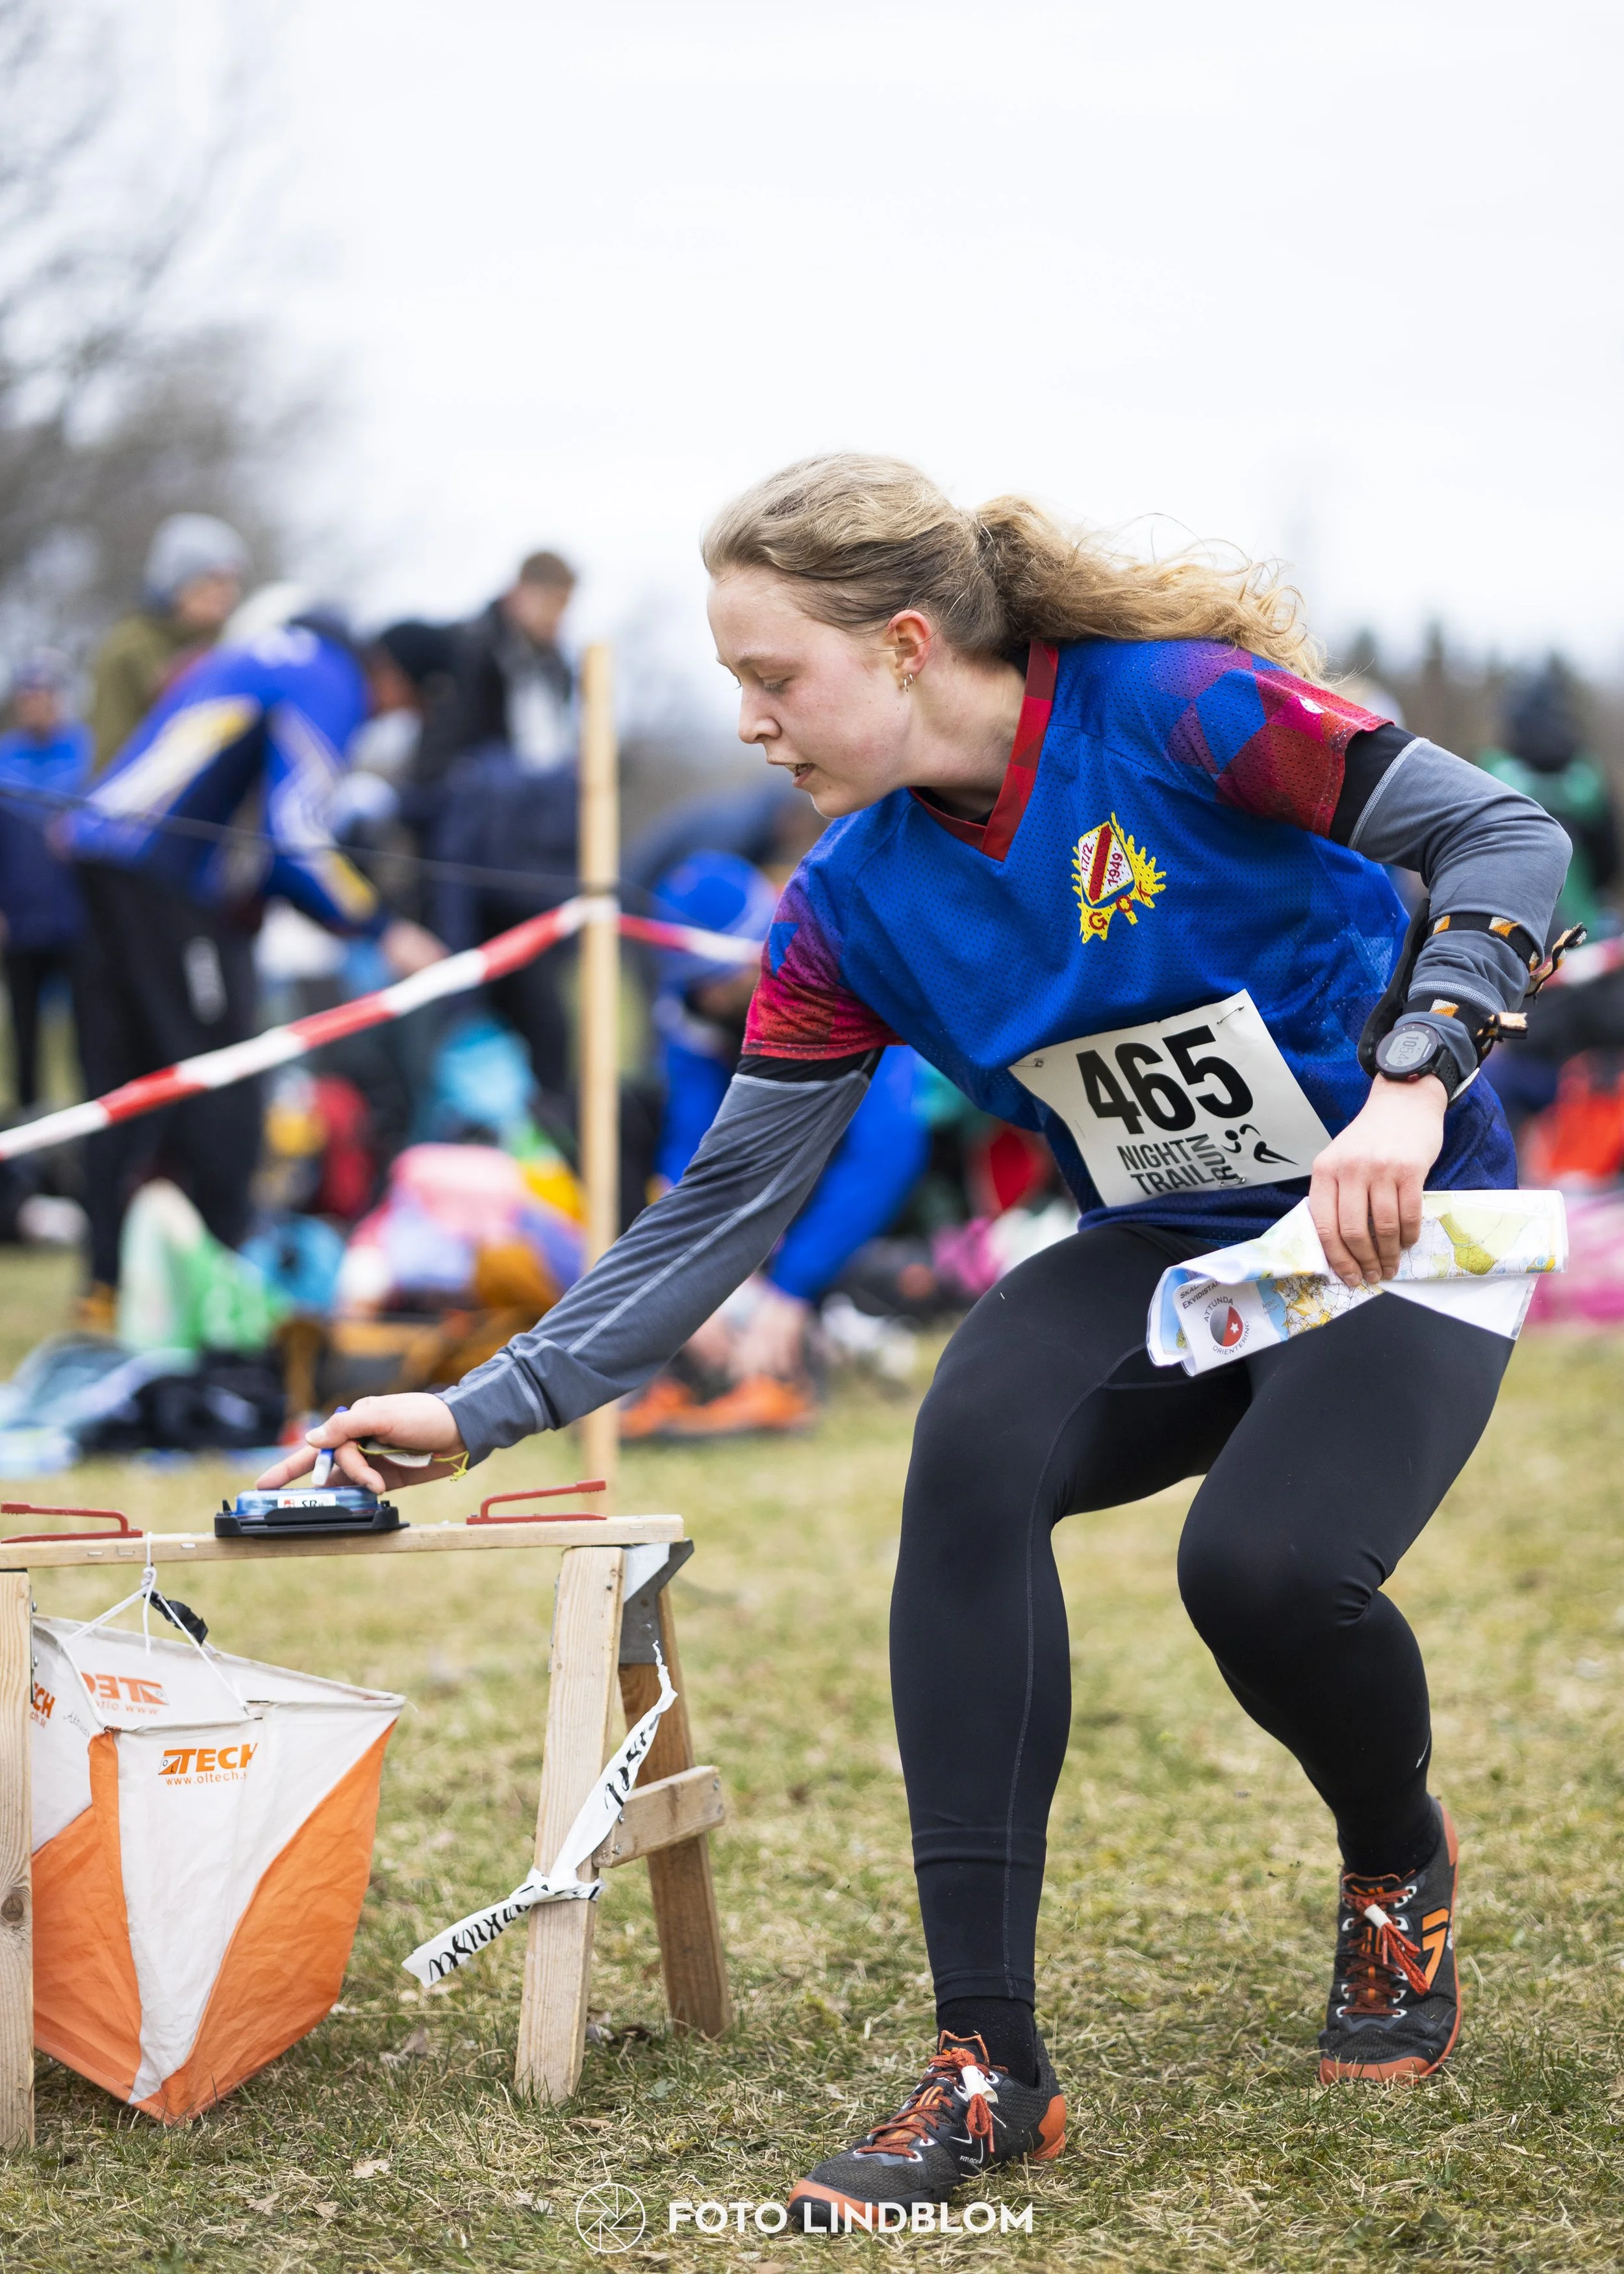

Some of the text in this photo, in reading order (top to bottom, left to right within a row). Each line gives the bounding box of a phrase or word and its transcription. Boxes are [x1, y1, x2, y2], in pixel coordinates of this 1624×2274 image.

[1081, 844, 1093, 872] 17/2
[1108, 852, 1124, 885] 1949
[1076, 1025, 1254, 1134] 465
[1116, 1139, 1193, 1170] NIGHT
[1185, 1133, 1238, 1181] RUN
[1130, 1164, 1215, 1195] TRAIL
[1180, 1284, 1201, 1299] SKAL
[1204, 1296, 1234, 1323] ATTUNDA
[1213, 1321, 1250, 1355] ORIENTERING
[166, 1770, 248, 1785] www.oltech.s
